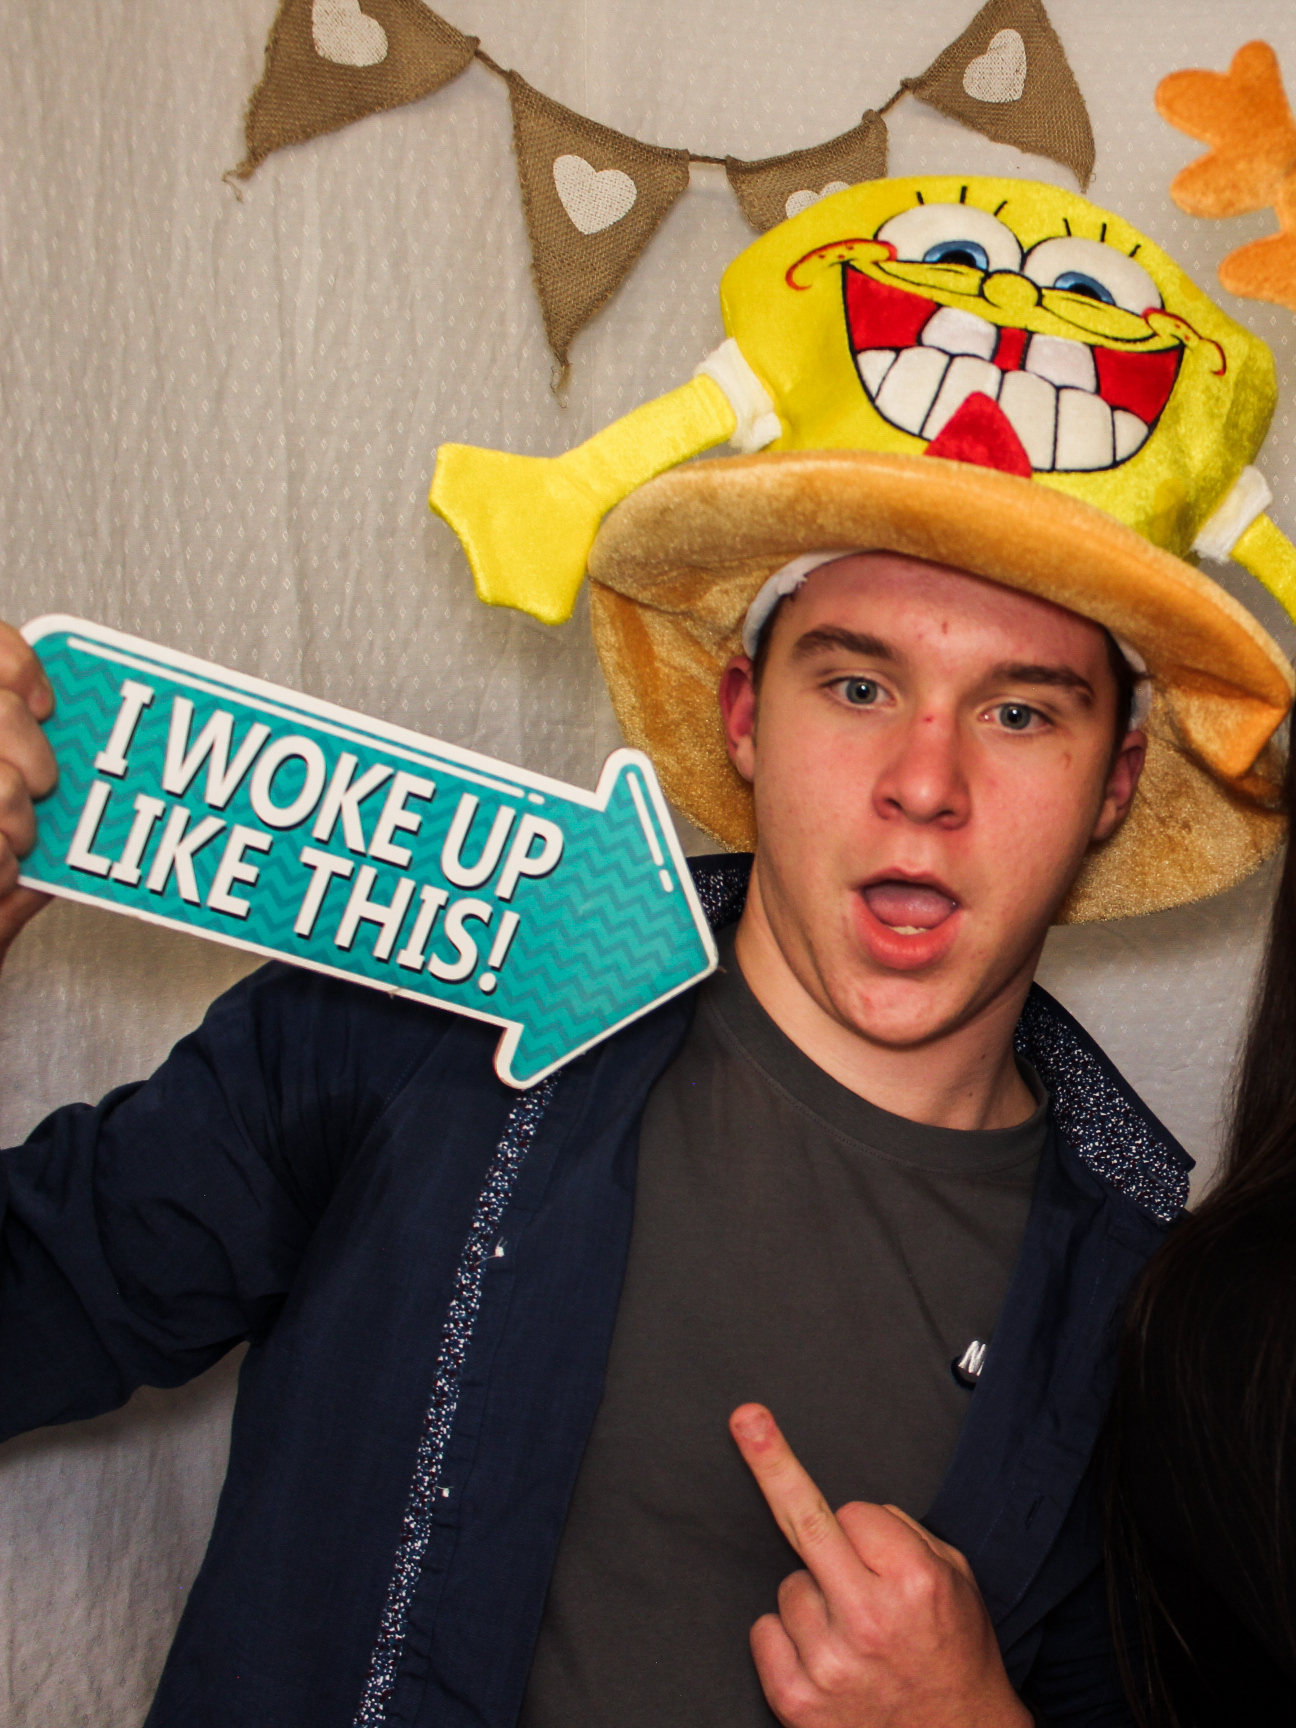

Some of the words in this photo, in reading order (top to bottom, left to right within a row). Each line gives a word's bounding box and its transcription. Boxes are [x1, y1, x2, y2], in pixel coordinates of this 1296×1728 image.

[66, 779, 274, 918] LIKE
[293, 845, 521, 993] THIS!
[95, 679, 155, 777] I
[162, 696, 437, 868] WOKE
[440, 792, 565, 900] UP
